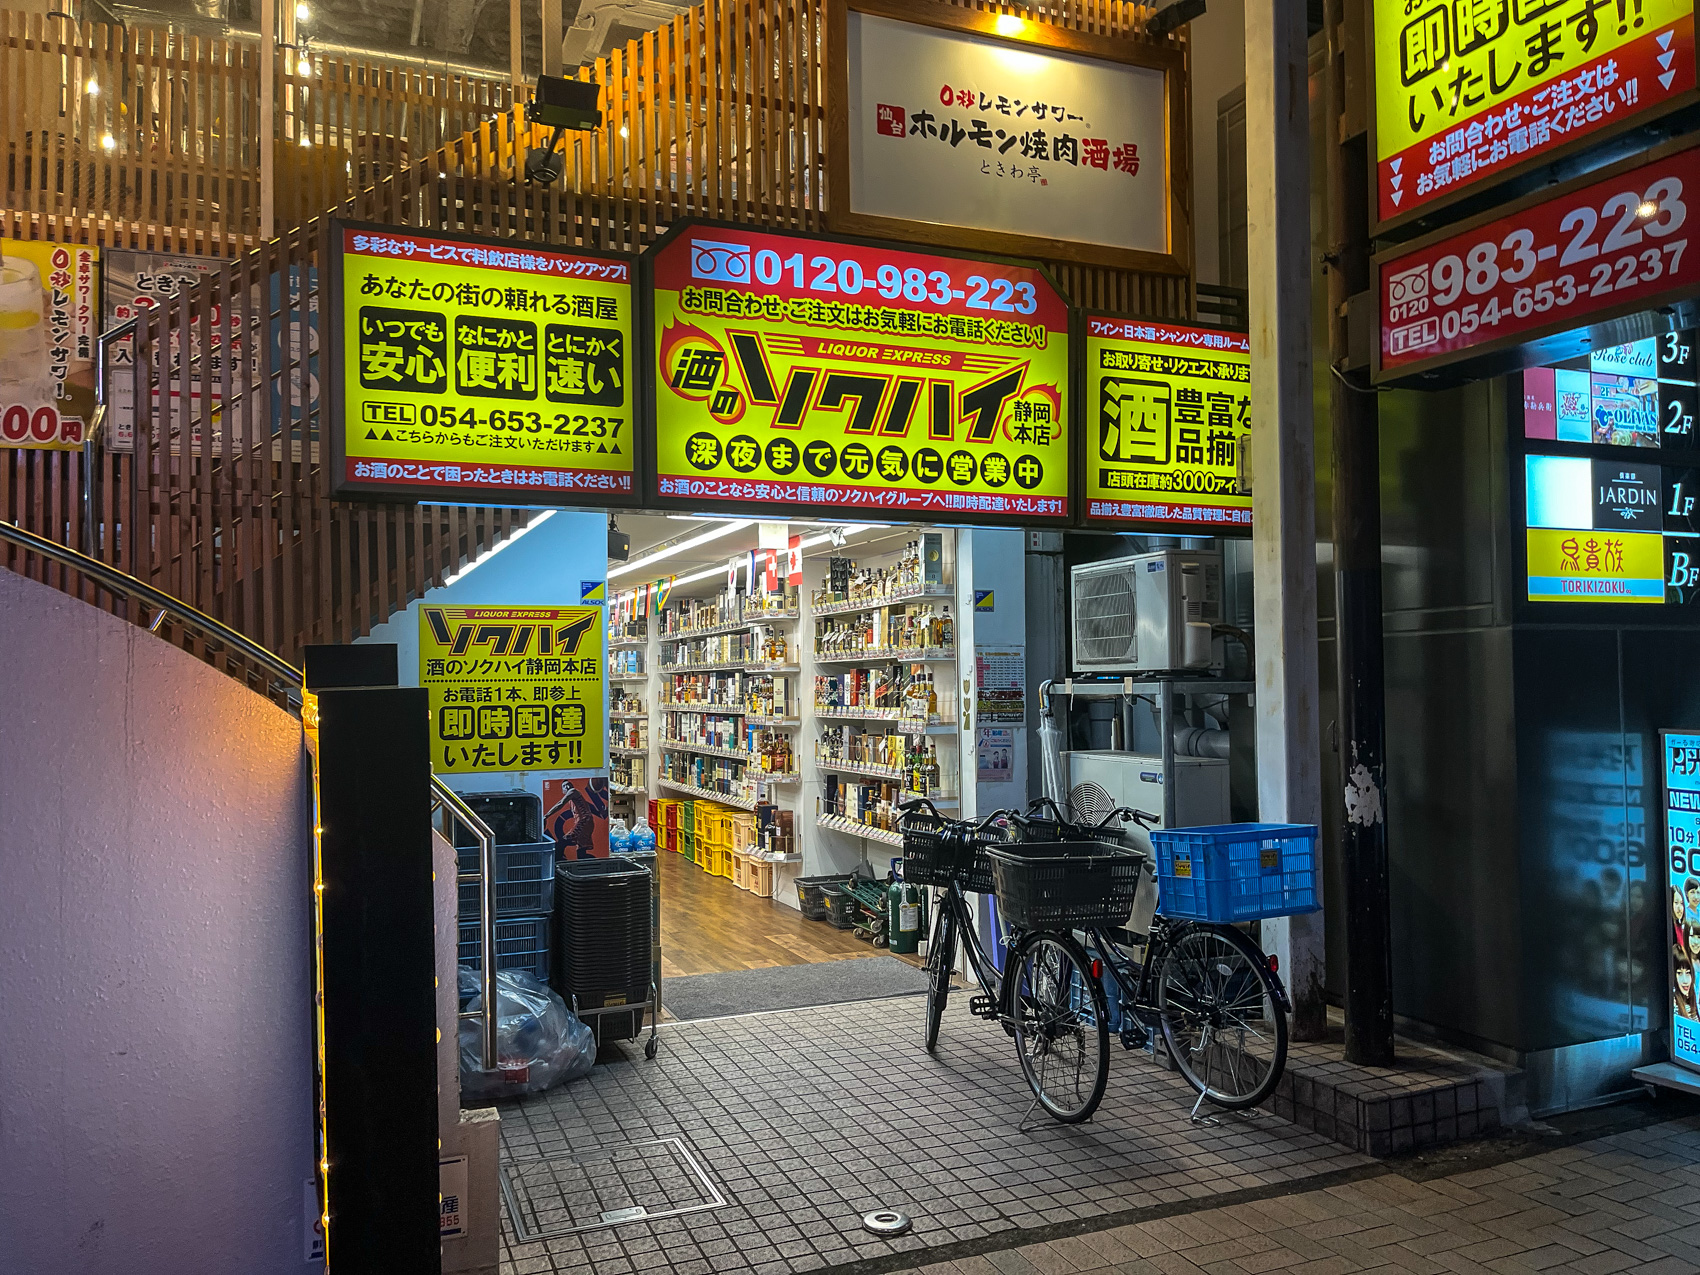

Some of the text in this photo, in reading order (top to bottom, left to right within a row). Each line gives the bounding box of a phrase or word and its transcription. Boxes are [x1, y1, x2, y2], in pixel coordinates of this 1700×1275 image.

[1429, 59, 1619, 165] お問合わせ・ご注文は
[909, 109, 1140, 177] ホルモン焼肉酒場
[1416, 78, 1639, 196] お気軽にお電話ください!!
[980, 159, 1041, 183] ときわ亭
[353, 235, 627, 280] 多彩なサービスで料飲店様をバックアップ!
[1432, 176, 1687, 307] 983-223
[360, 273, 618, 321] あなたの街の頼れる酒屋
[755, 249, 1038, 314] 0120-983-223
[1394, 239, 1688, 346] TEL 054-653-2237
[1389, 298, 1429, 323] 0120
[362, 316, 444, 342] いつでも
[458, 325, 534, 350] なにかと
[548, 333, 620, 358] とにかく
[362, 342, 446, 384] 安心
[817, 343, 952, 366] LIQUOR EXPRESS
[1629, 352, 1653, 367] club
[1661, 331, 1690, 365] 3F
[457, 347, 535, 392] 便利
[547, 358, 622, 395] 速い
[671, 348, 740, 416] 酒の
[1103, 351, 1250, 381] お取り寄せ・リクエスト承りま
[726, 330, 1029, 443] ソクハイ
[0, 405, 82, 443] 00円
[366, 404, 624, 439] TEL 054-653-2237
[1013, 399, 1050, 423] 静岡
[1102, 380, 1169, 462] 酒
[1664, 400, 1693, 434] 2F
[396, 430, 595, 453] こちらからもご注文いただけます
[1013, 423, 1050, 447] 本店
[355, 462, 631, 490] お酒のことで困ったときはお電話ください!!
[689, 436, 1040, 488] 深夜まで元気に営業中
[1107, 469, 1238, 495] 店頭在庫約3000アイ
[1599, 486, 1657, 505] JARDIN
[1090, 502, 1252, 524] 品揃え豊富!徹底した品質管理に自信
[1667, 483, 1695, 517] 1F
[1560, 580, 1625, 594] TORIKIZOKU
[1668, 552, 1699, 588] BF
[424, 608, 598, 656] ソクハイ
[426, 658, 597, 676] 酒のソクハイ静岡本店
[441, 706, 585, 739] 即時配達
[444, 740, 582, 767] いたします!!
[1677, 1025, 1696, 1041] TEL
